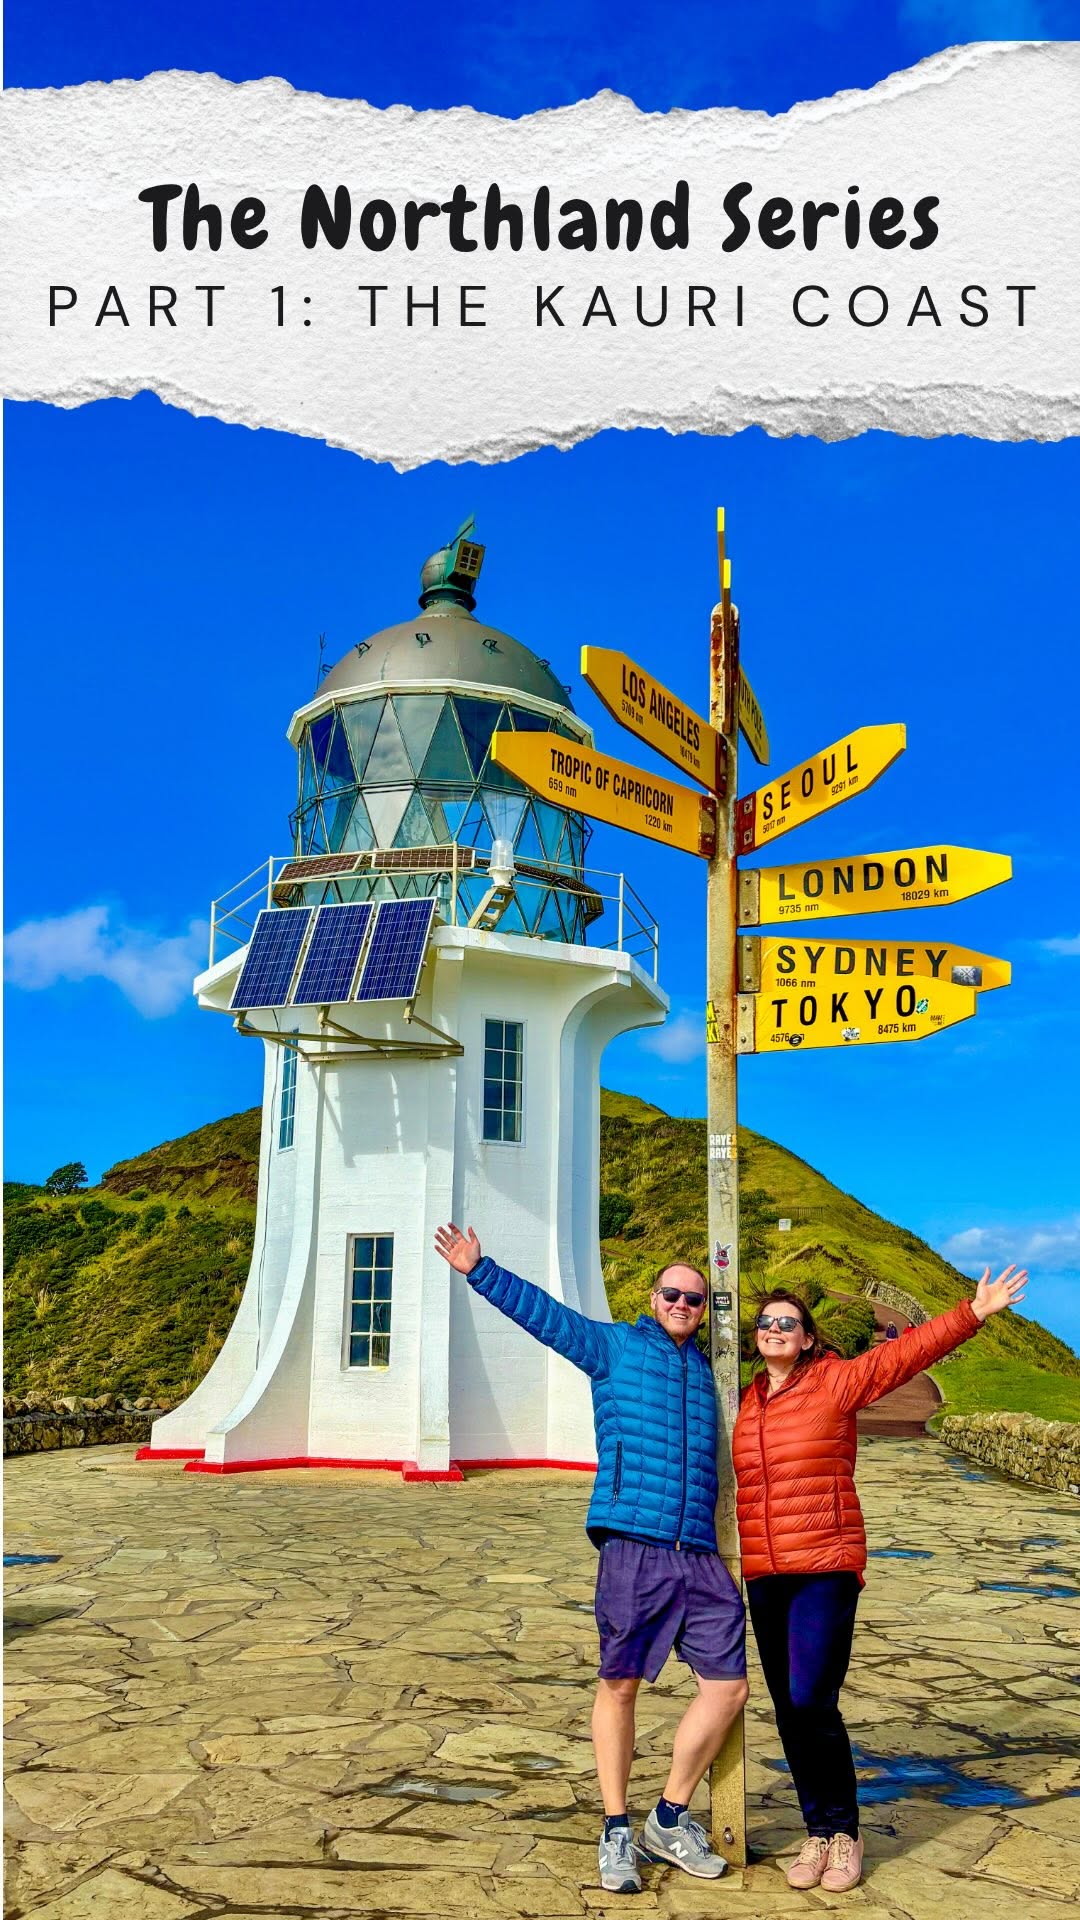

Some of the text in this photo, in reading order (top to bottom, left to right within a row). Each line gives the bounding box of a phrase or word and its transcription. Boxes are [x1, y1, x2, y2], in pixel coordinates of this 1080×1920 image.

[622, 664, 700, 751] LOS ANGELES
[548, 777, 577, 798] 659 nm
[550, 748, 674, 816] TROPIC OF CAPRICORN
[763, 744, 858, 821] SEOUL
[831, 775, 859, 796] 9291 km
[644, 814, 673, 833] 1220 km
[762, 815, 786, 834] 5017 nm
[778, 853, 948, 901] LONDON
[900, 888, 949, 901] 18029 km
[778, 903, 819, 915] 9735 nm
[776, 945, 948, 978] SYDNEY
[775, 978, 816, 988] 1066 nm
[771, 984, 916, 1028] TOKYO
[770, 1032, 790, 1043] 4576
[877, 1022, 916, 1035] 8475 km
